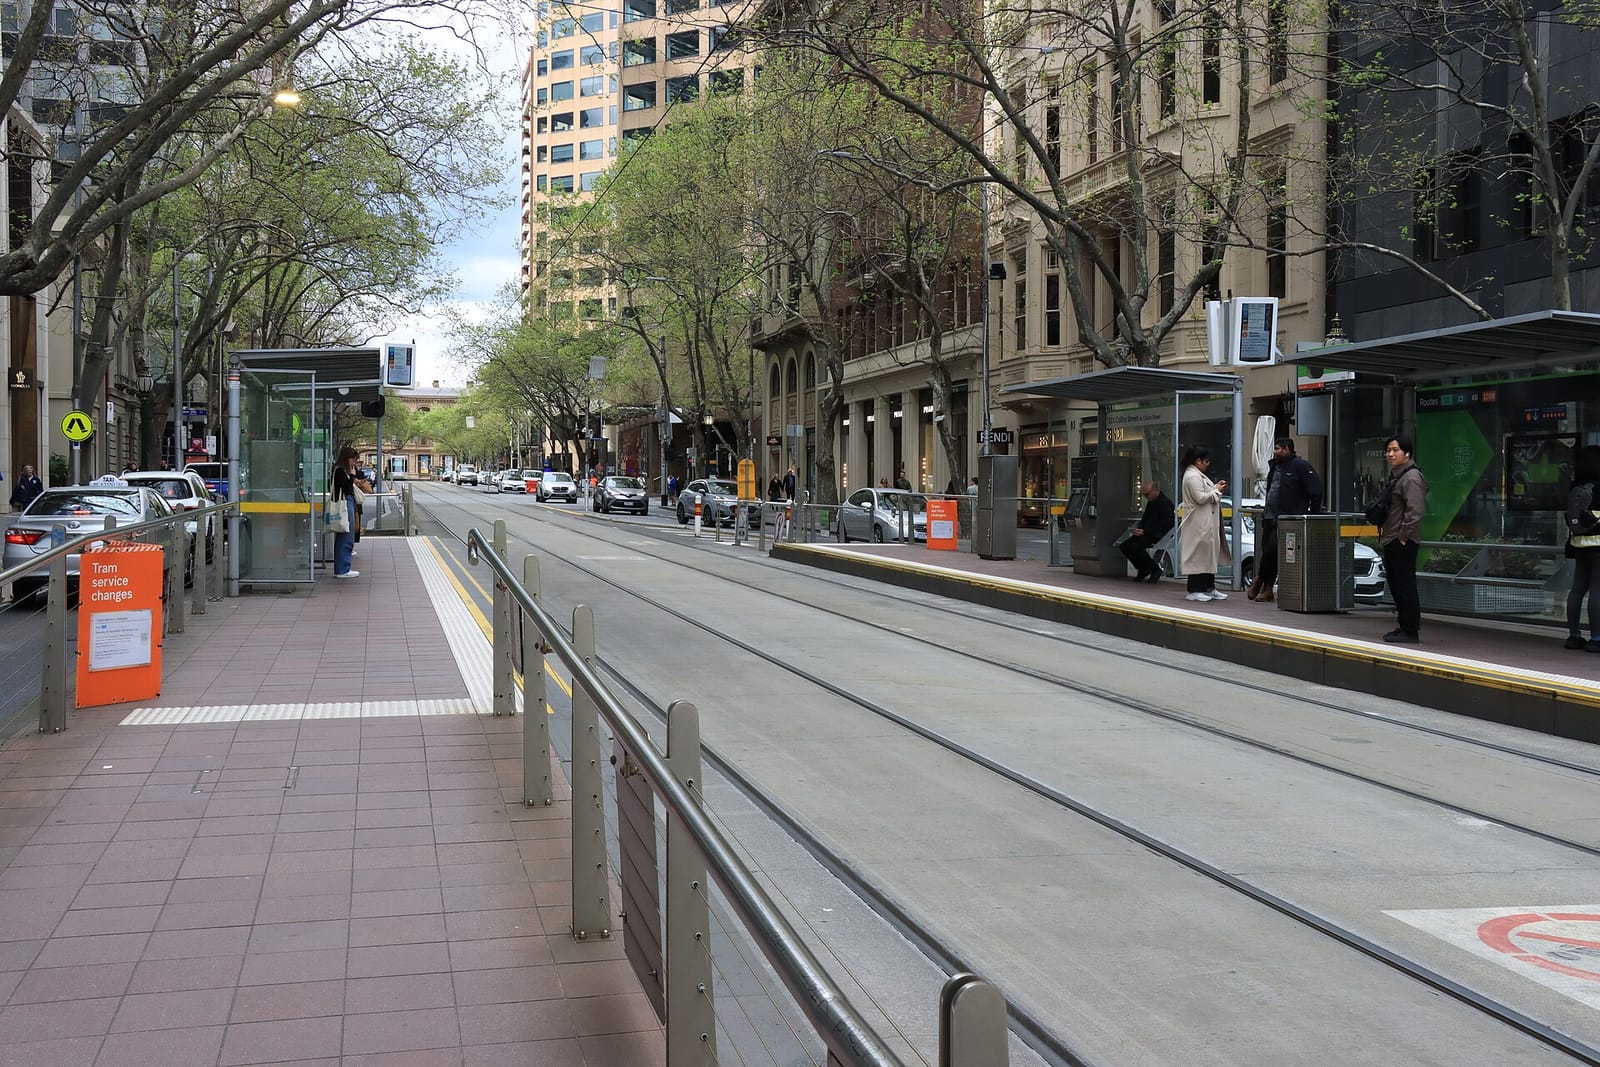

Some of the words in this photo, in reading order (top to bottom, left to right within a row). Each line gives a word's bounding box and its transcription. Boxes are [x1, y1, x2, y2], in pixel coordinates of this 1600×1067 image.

[1419, 398, 1439, 406] Routes
[980, 432, 1011, 443] FENDI
[92, 562, 118, 574] Tram
[91, 575, 129, 588] service
[91, 589, 133, 603] changes
